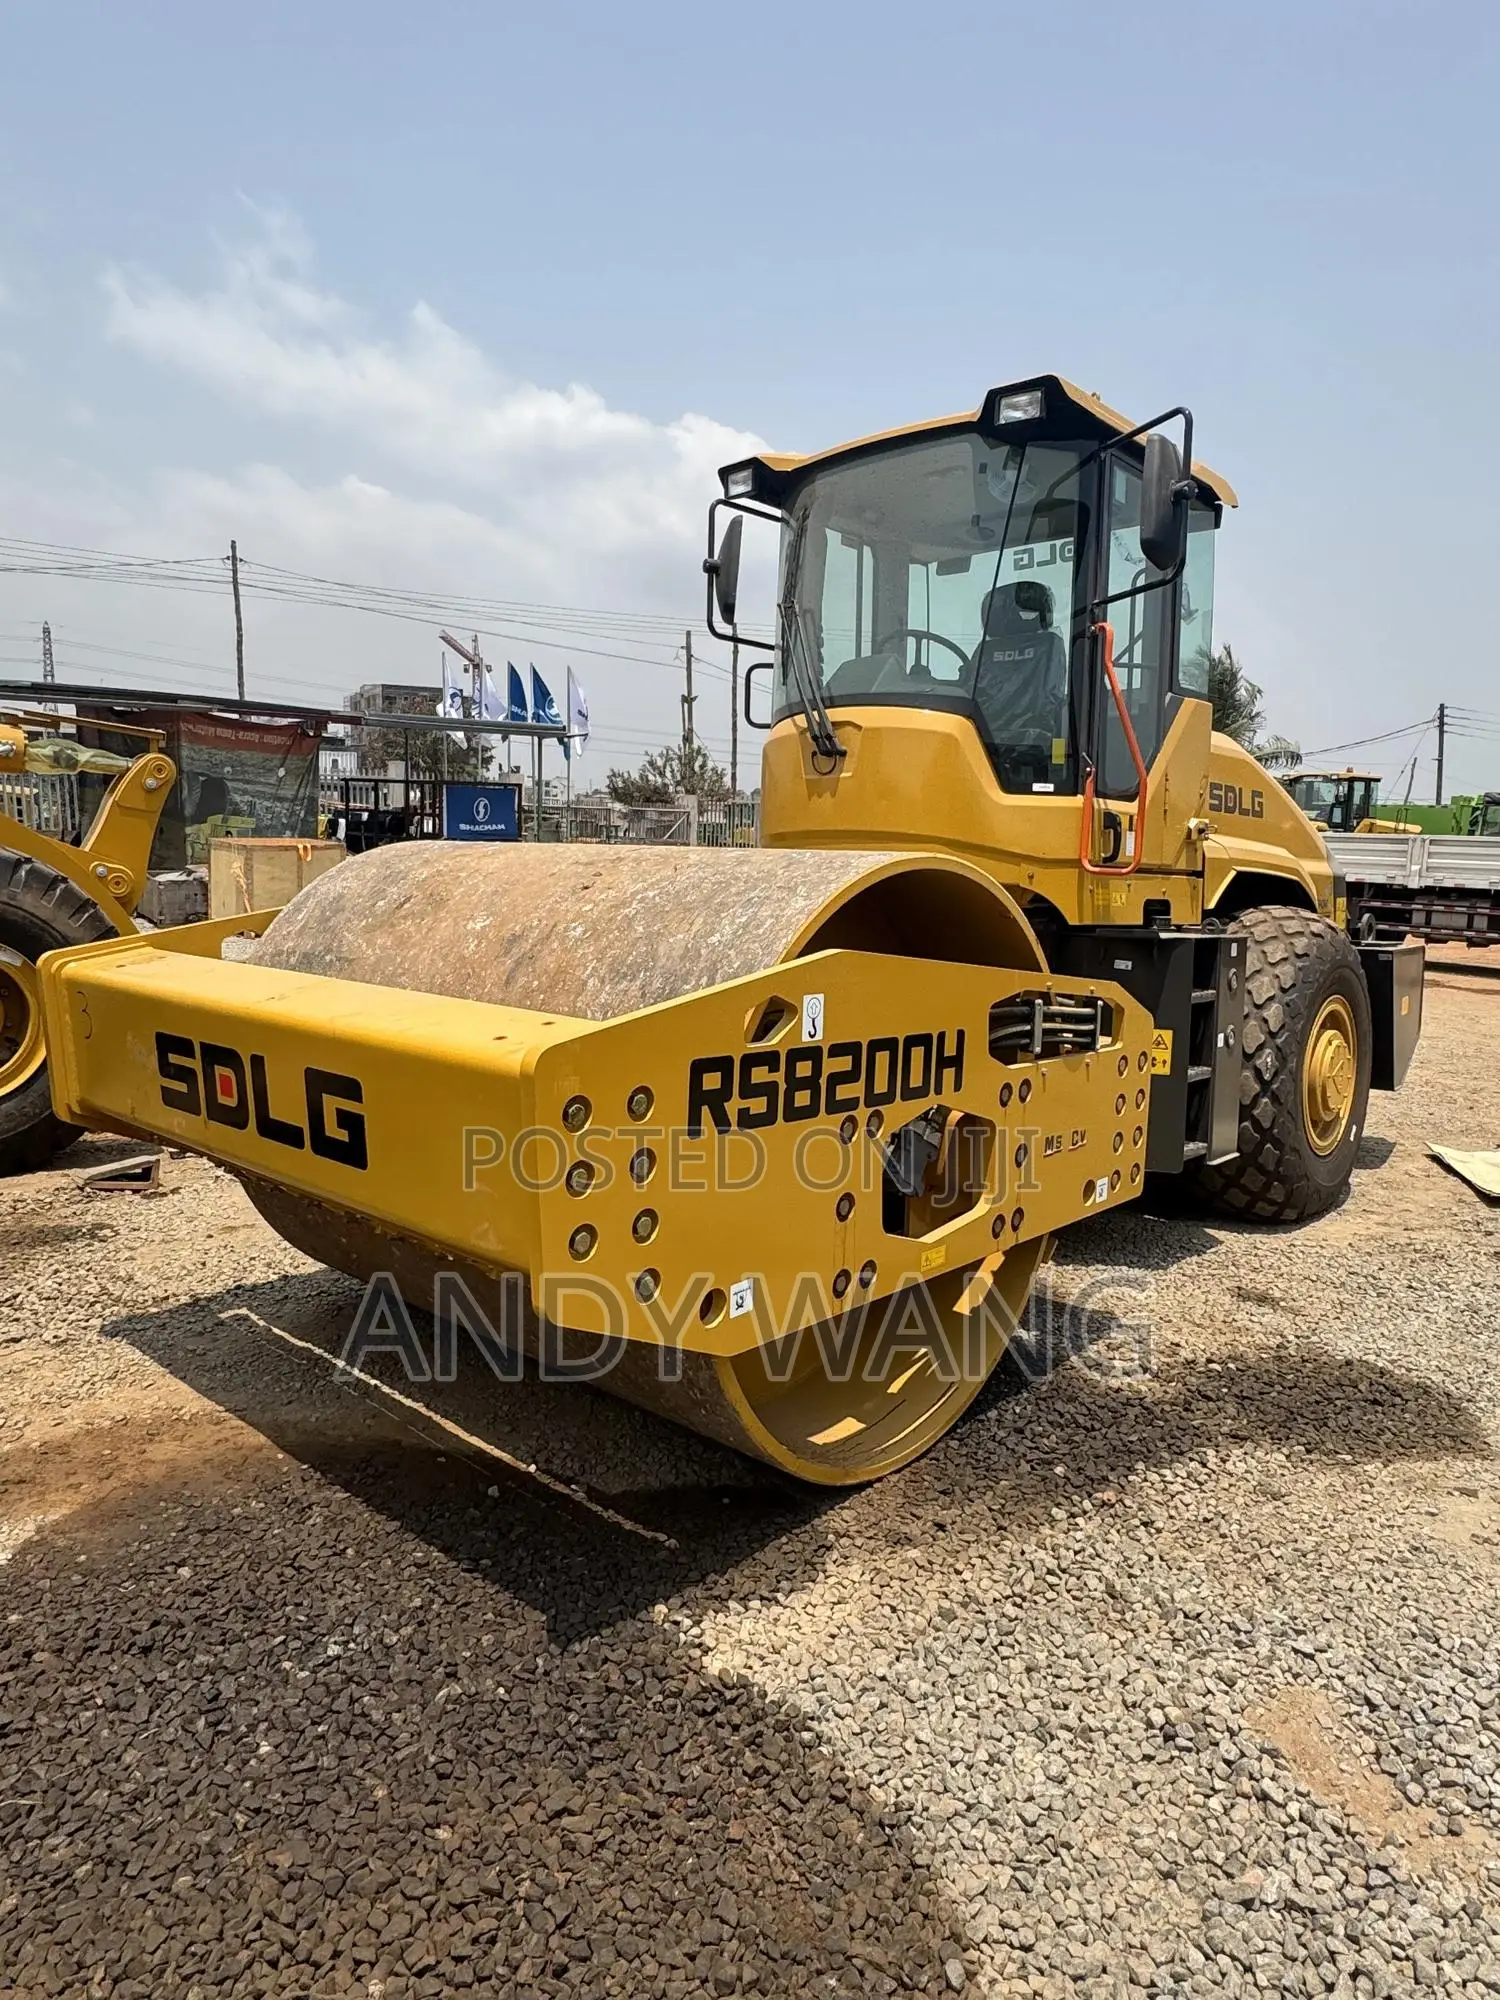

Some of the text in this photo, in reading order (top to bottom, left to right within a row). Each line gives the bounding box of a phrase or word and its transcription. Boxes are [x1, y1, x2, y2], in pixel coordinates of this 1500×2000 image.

[993, 647, 1034, 661] SDLG
[1209, 782, 1263, 818] SDLG
[155, 1031, 368, 1171] SDLG
[687, 1028, 966, 1141] RS8200H
